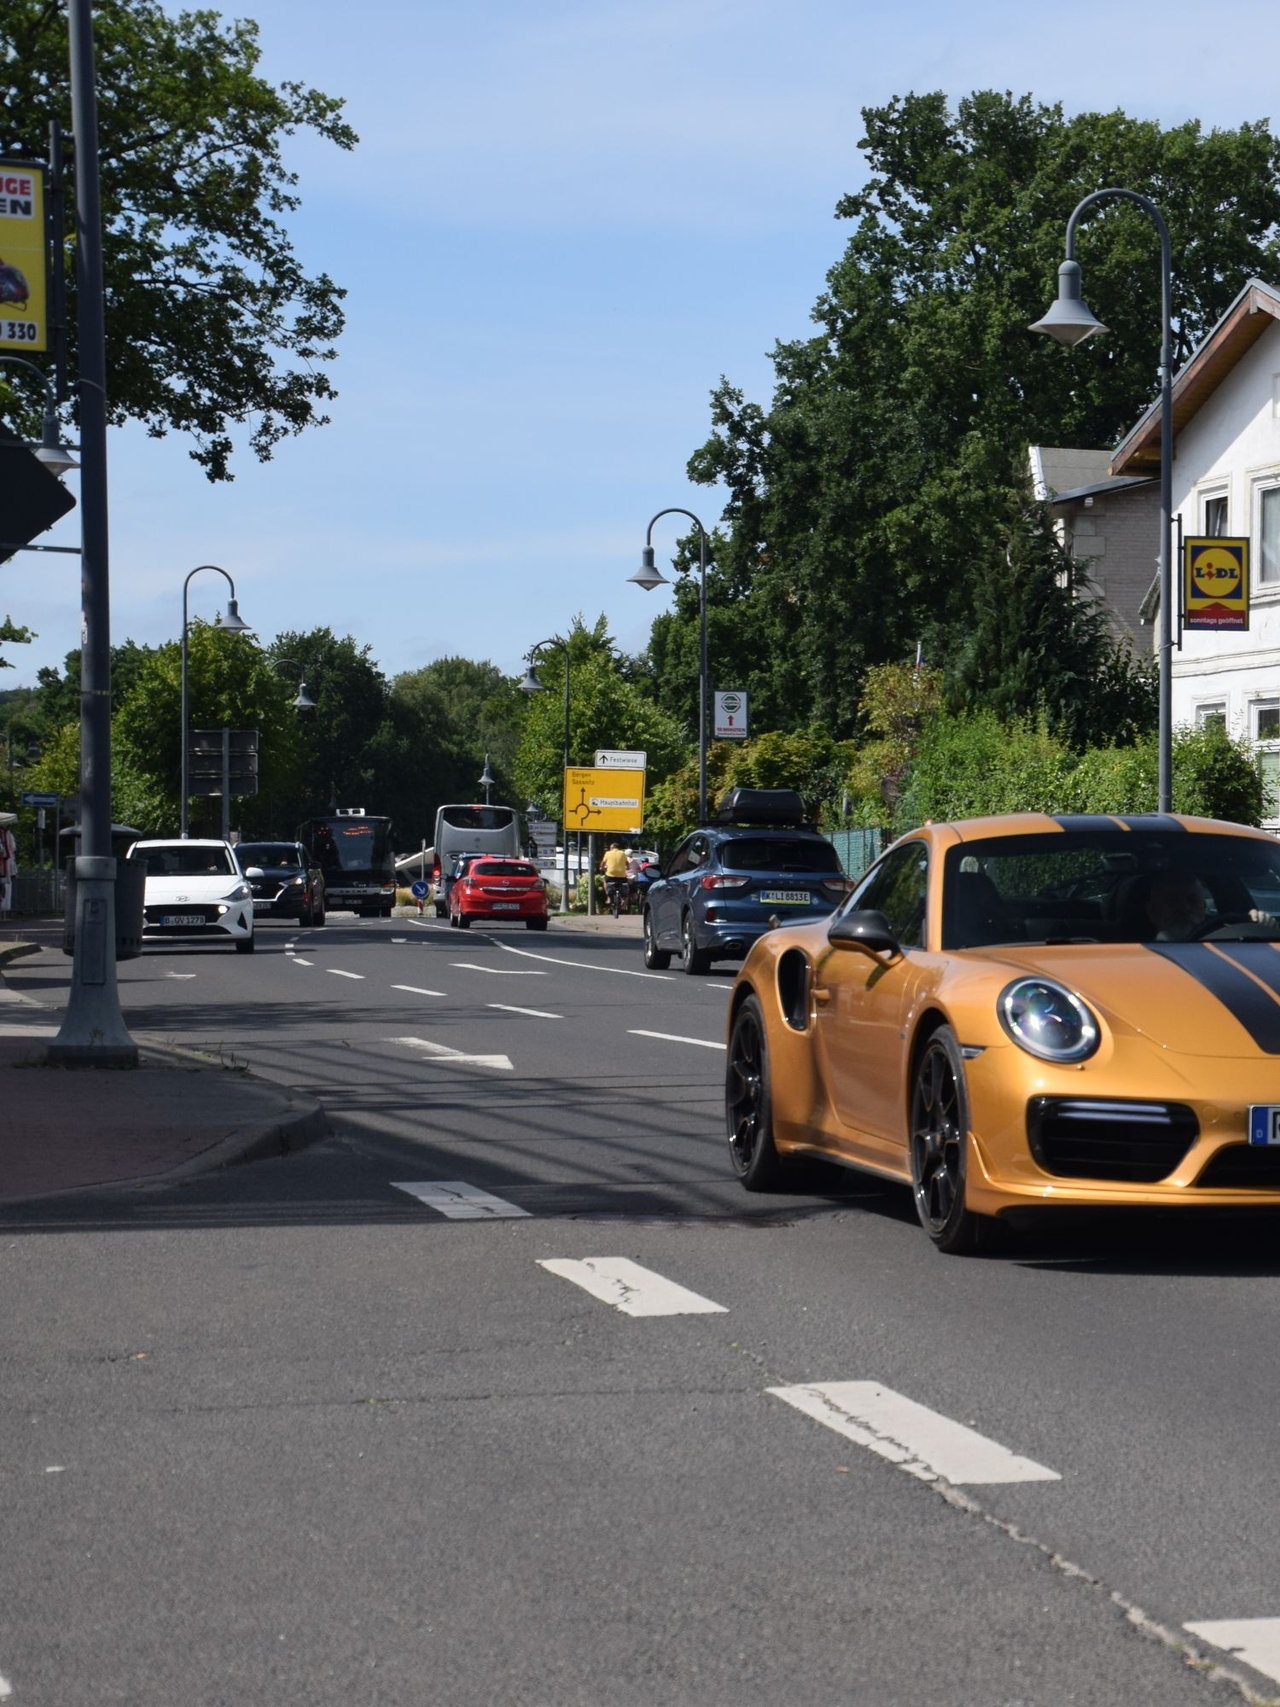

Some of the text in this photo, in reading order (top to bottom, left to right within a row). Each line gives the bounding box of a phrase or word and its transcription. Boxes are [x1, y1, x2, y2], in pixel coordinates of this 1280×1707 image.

[0, 178, 30, 196] GE
[8, 322, 36, 341] 330
[1190, 617, 1243, 625] sonntags geöffnet
[610, 756, 638, 764] Festwiese
